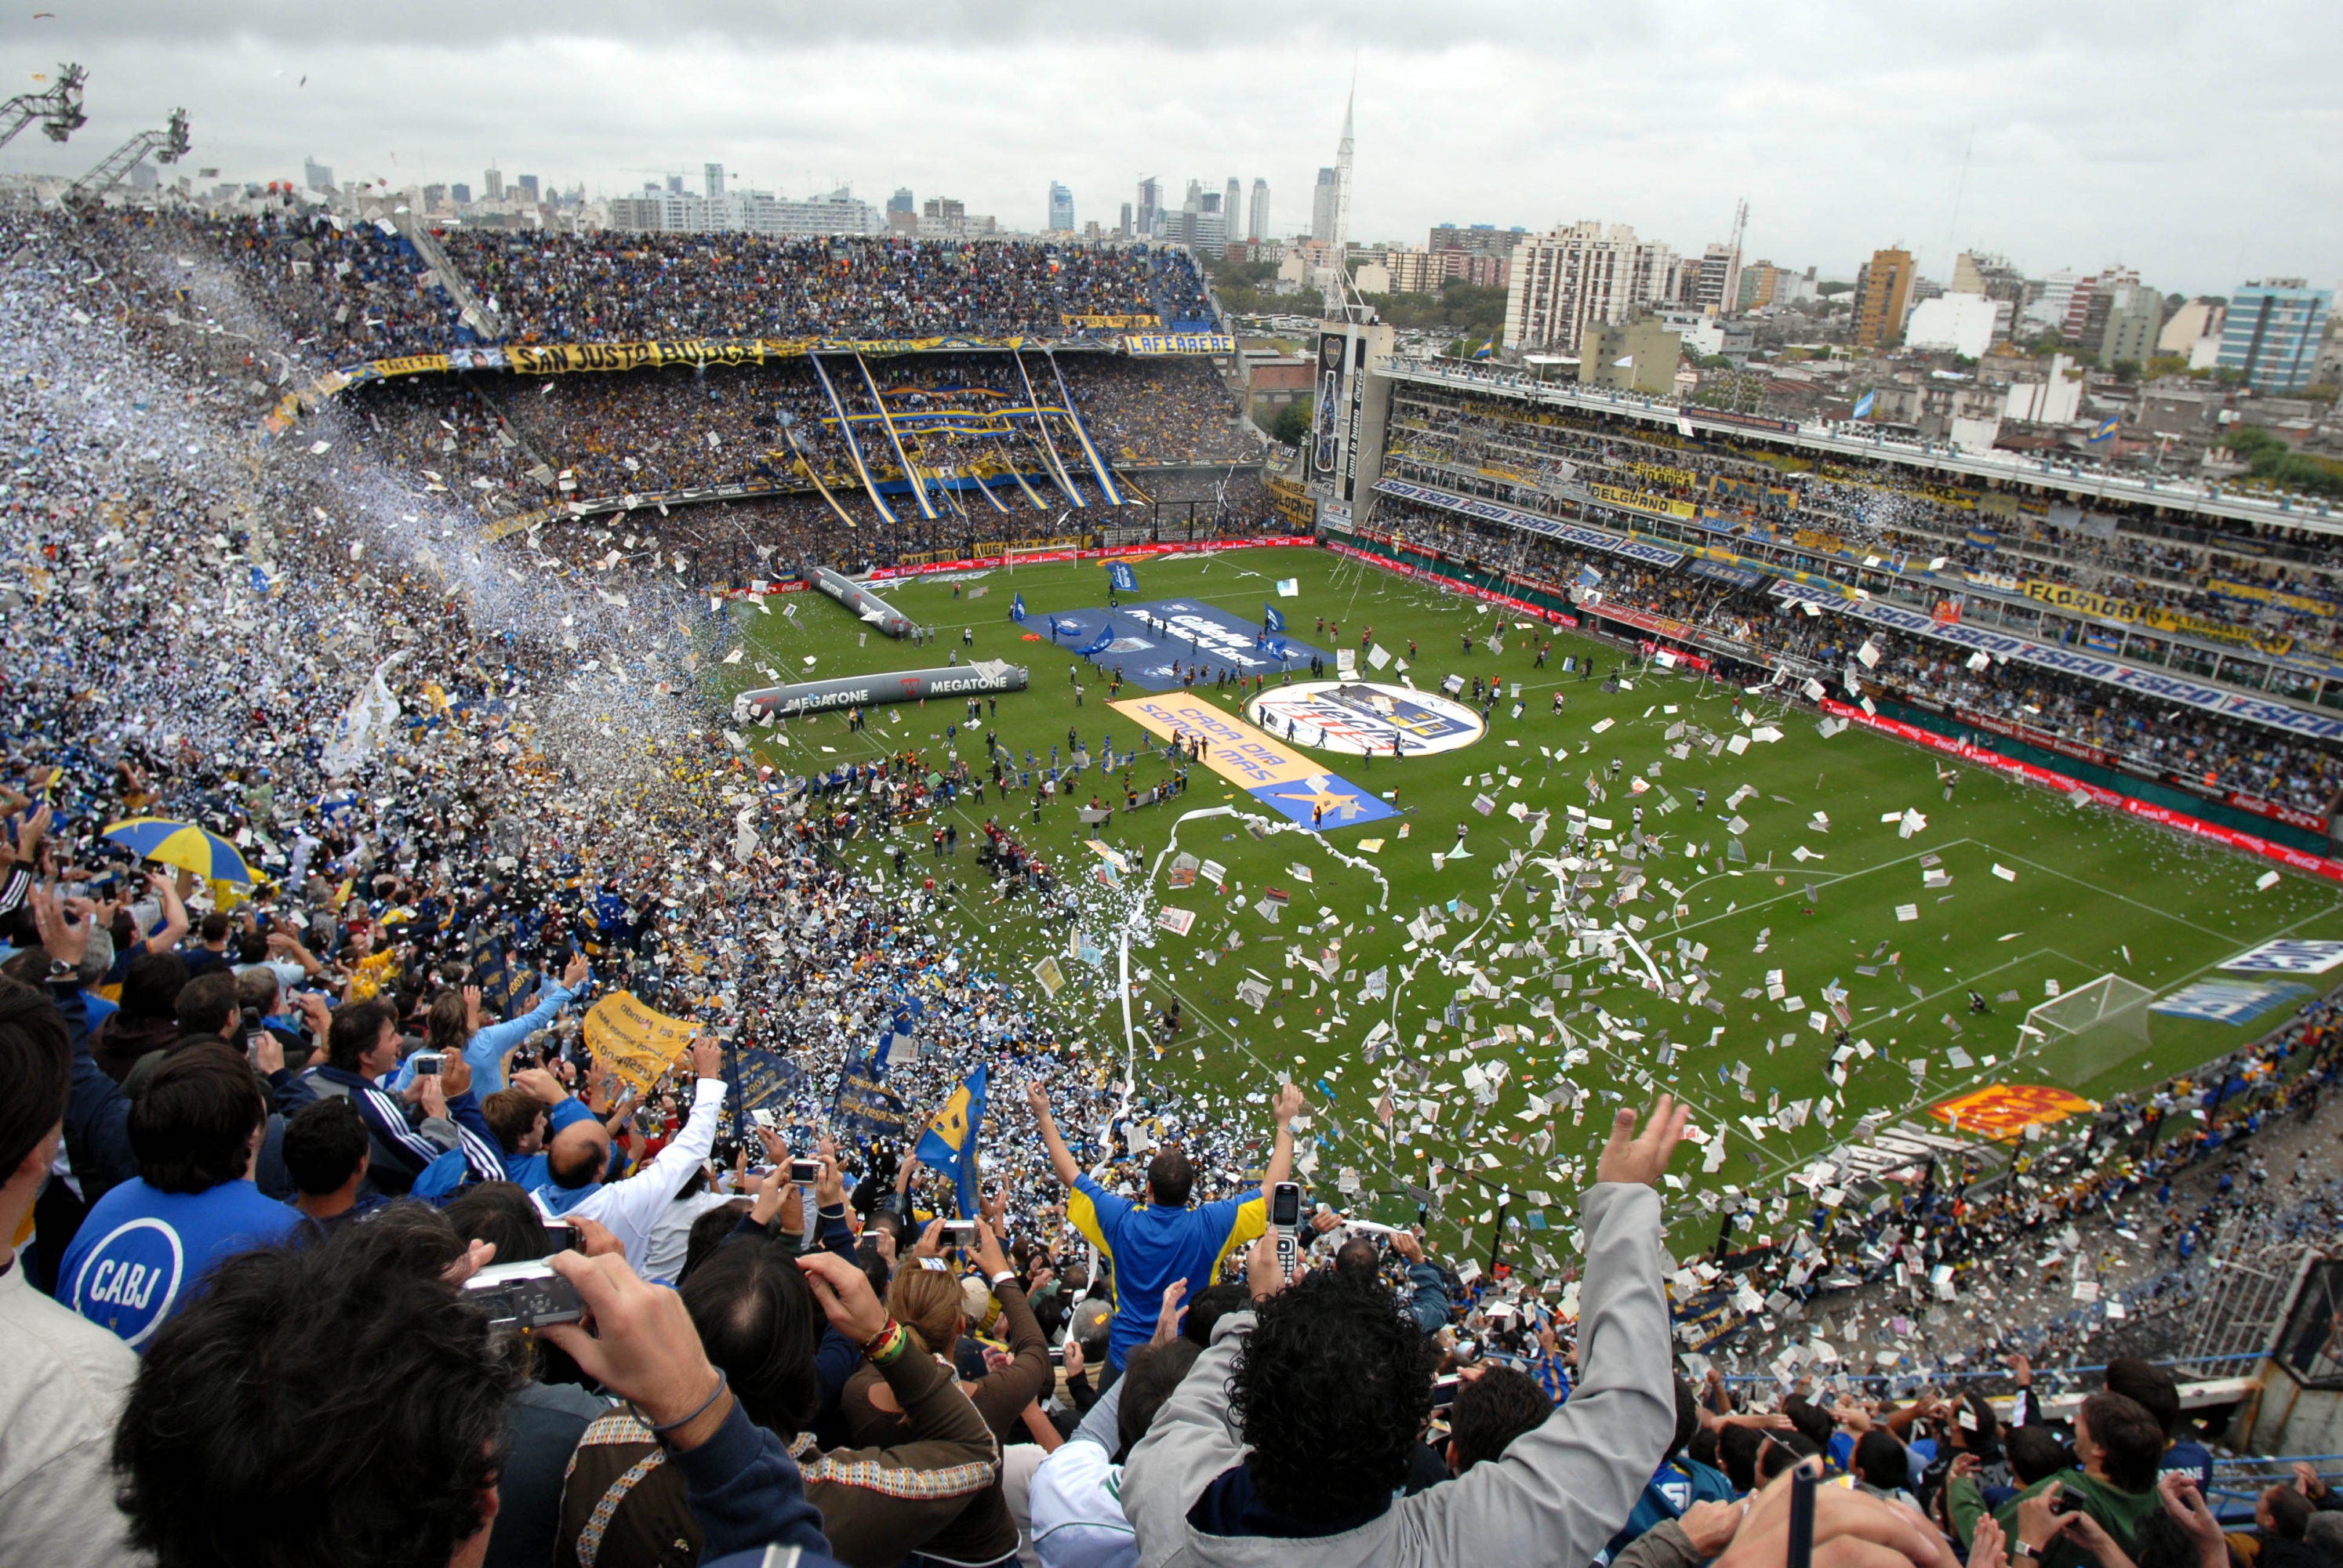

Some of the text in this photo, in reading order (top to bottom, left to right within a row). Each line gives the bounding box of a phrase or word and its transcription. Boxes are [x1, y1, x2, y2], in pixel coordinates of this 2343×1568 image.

[517, 347, 568, 372] SAN
[575, 343, 650, 370] JUSTO
[1129, 336, 1233, 354] LAFERRERE
[1353, 366, 1364, 403] Coca-Cola
[1349, 408, 1360, 441] bueno
[1310, 478, 1334, 495] Coca-Cola
[1593, 486, 1669, 512] BELGRANO
[782, 582, 804, 592] Coca-Cola
[819, 578, 844, 600] MEGATONE
[1931, 622, 2019, 652] ESCO
[2018, 643, 2115, 677] ESCO
[2114, 668, 2222, 704] ESCO
[1980, 716, 2013, 735] Emapi
[2224, 696, 2342, 737] ESCO
[1178, 707, 1287, 765] CADA DIA
[2054, 739, 2090, 759] Emapi
[1214, 749, 1279, 782] MAS
[743, 1076, 766, 1097] 2007
[848, 1074, 872, 1090] Todos
[855, 1102, 887, 1121] Crespi
[90, 1258, 162, 1309] CABJ
